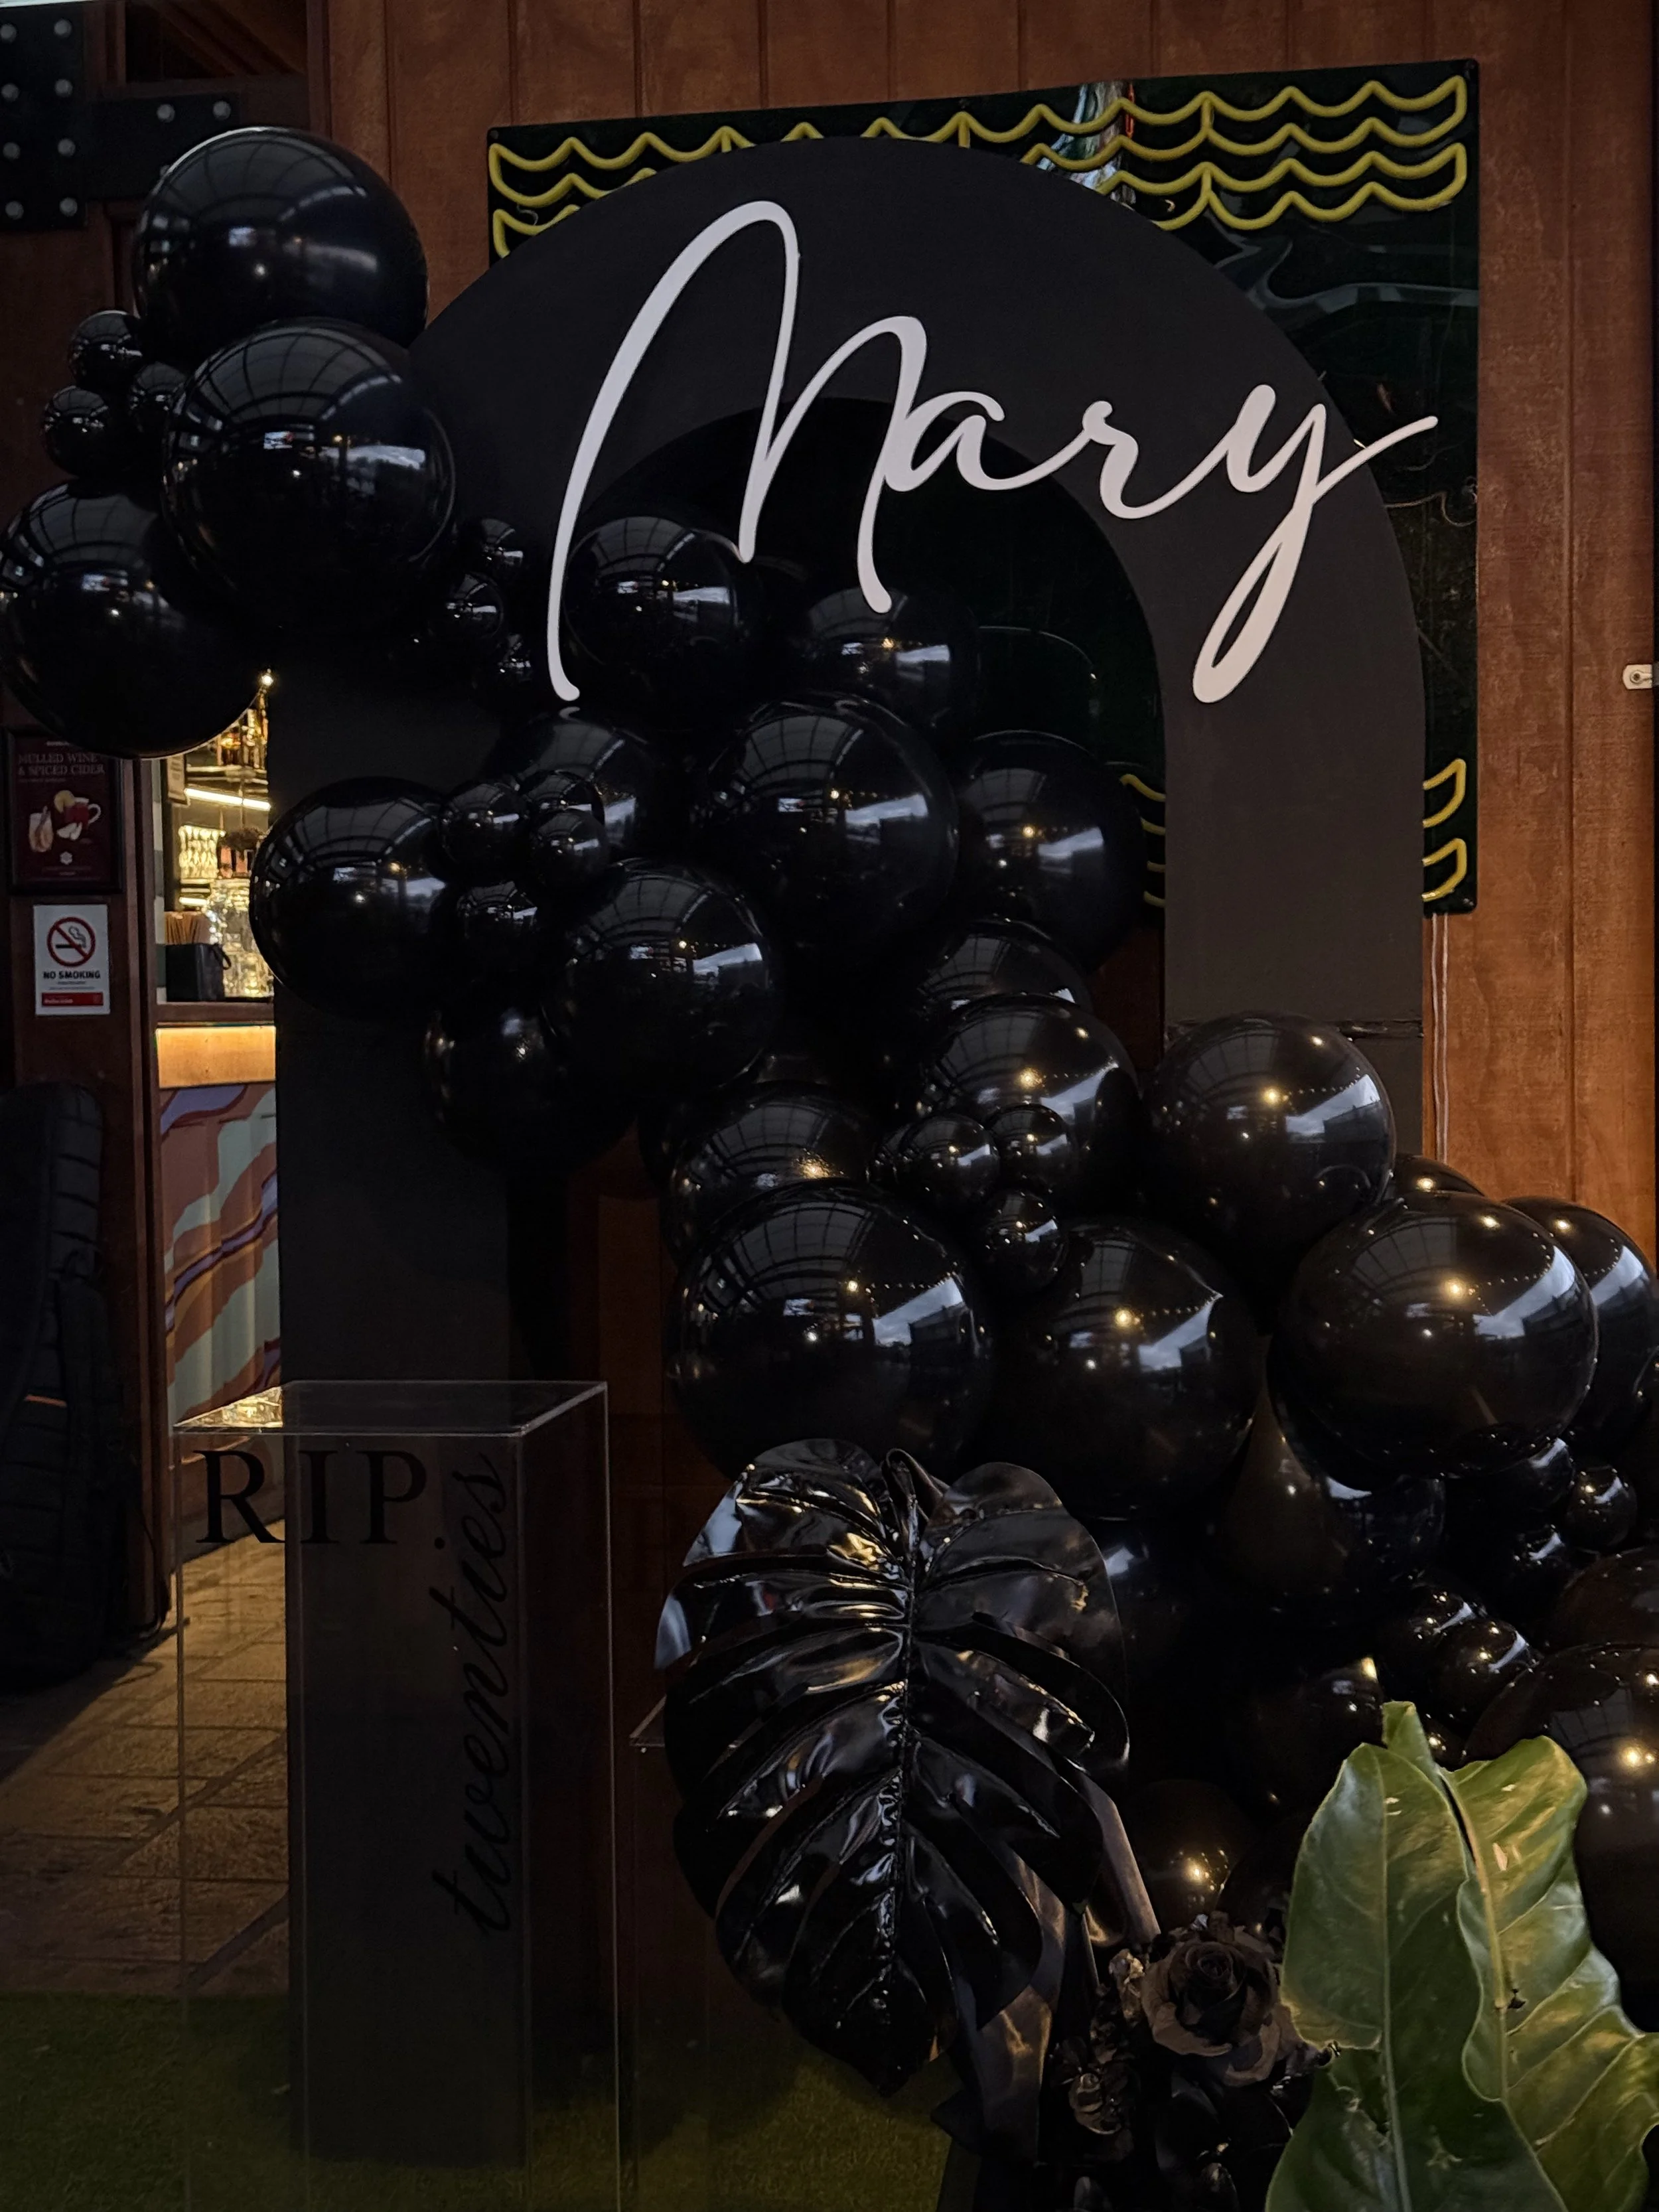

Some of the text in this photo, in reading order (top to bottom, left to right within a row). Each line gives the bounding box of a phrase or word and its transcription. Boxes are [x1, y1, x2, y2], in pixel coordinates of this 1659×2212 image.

[547, 200, 1437, 702] Mary
[18, 753, 98, 764] MULLED WINE
[18, 764, 105, 776] & SPICED CIDER
[58, 970, 100, 979] SMOKING
[429, 1451, 510, 1937] twenties
